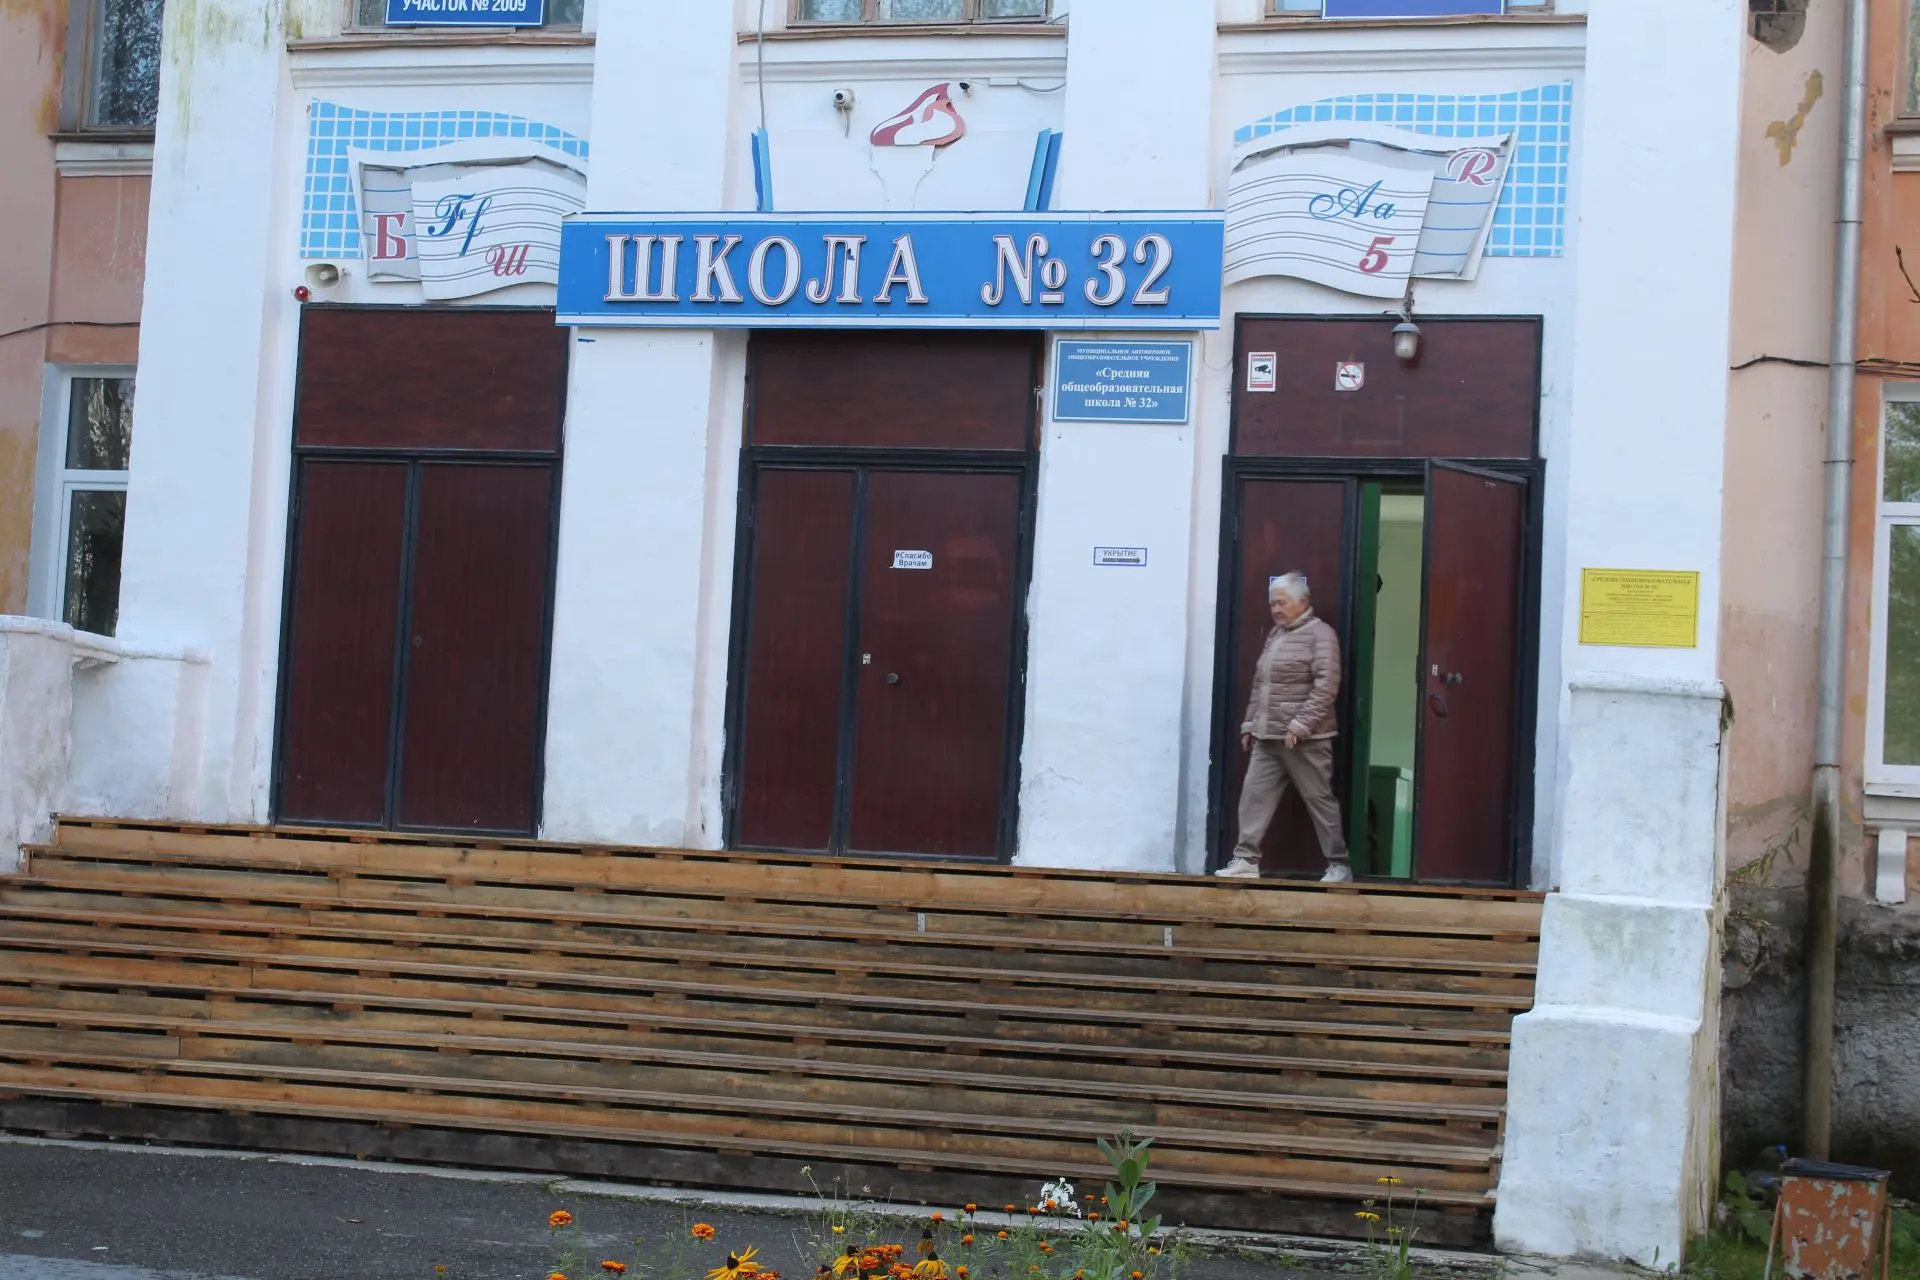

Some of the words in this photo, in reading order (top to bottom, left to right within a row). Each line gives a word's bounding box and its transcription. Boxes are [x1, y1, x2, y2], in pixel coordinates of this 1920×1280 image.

[402, 0, 468, 11] УЧАСТОК
[491, 0, 526, 11] 2009
[1446, 148, 1498, 187] R
[371, 213, 408, 261] Б
[1358, 236, 1396, 273] 5
[603, 233, 929, 307] ШКОЛА
[980, 233, 1067, 305] №
[1083, 233, 1174, 306] 32
[1096, 367, 1150, 380] «Средняя
[1061, 381, 1183, 395] общеобразовательная
[1084, 398, 1121, 408] школа
[1123, 397, 1137, 408] №
[1139, 397, 1159, 408] 32»
[895, 551, 931, 560] #Спасибо
[1103, 549, 1137, 557] УКРЫТИЕ
[898, 559, 927, 567] Врачам
